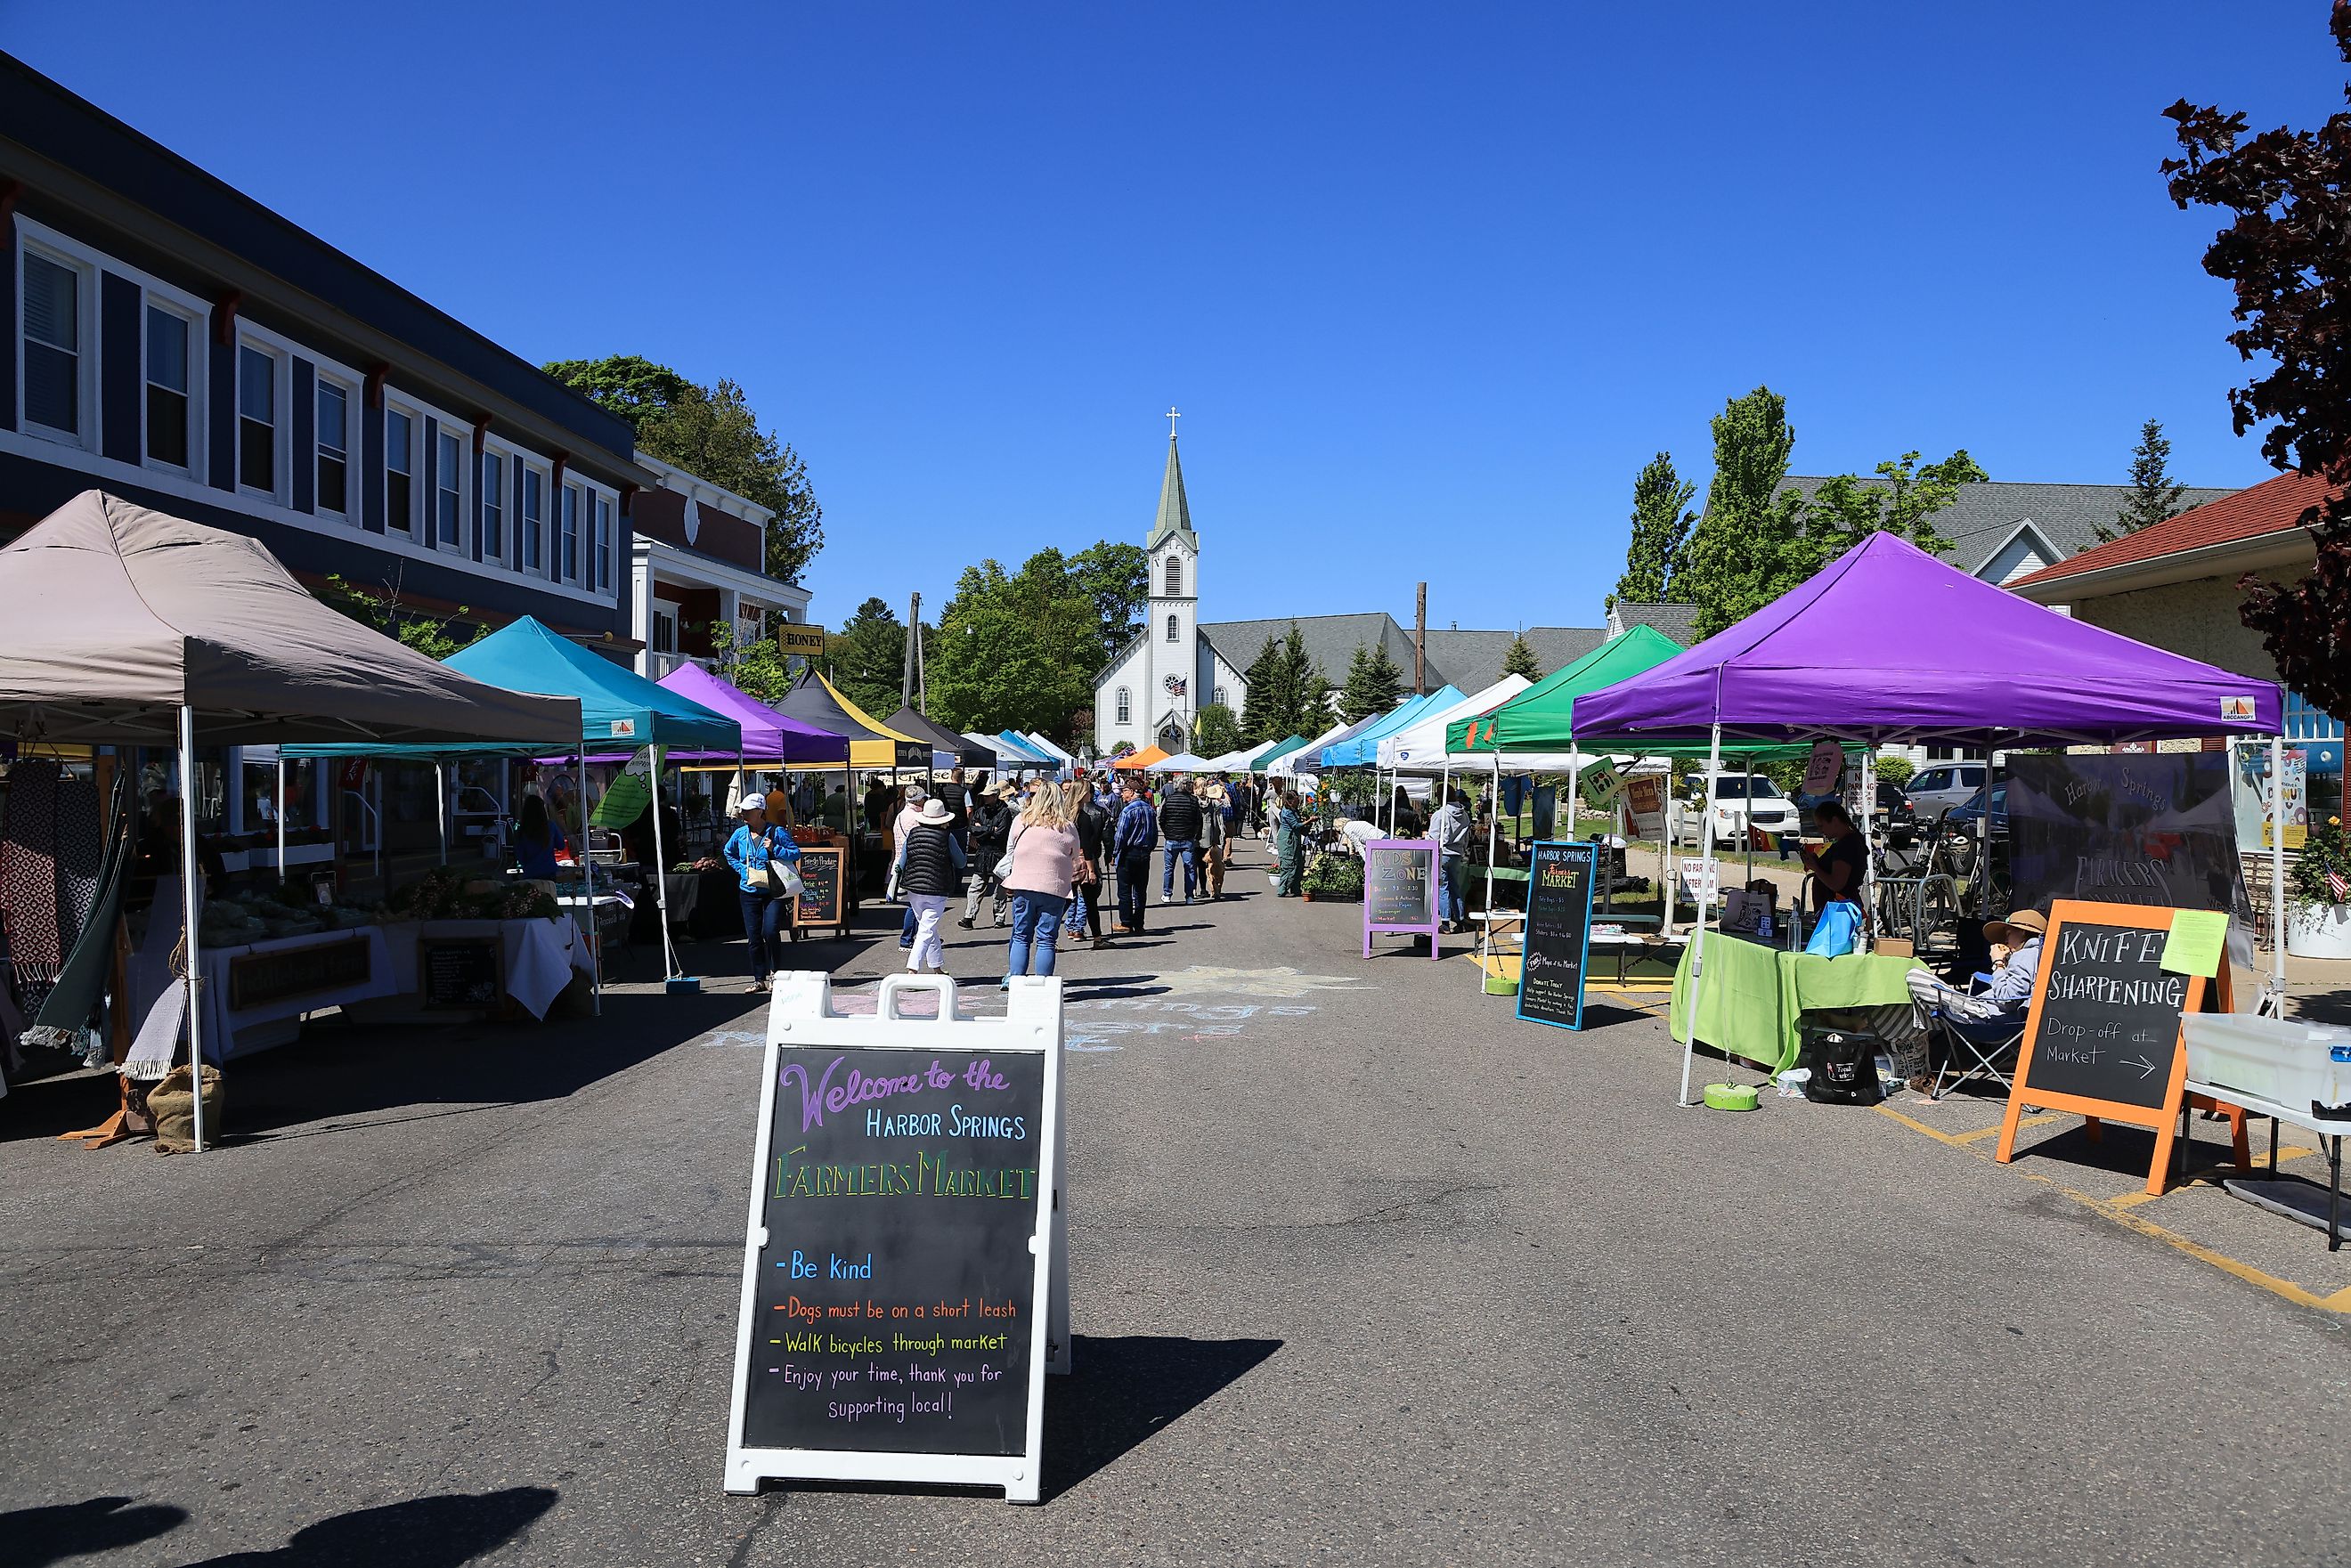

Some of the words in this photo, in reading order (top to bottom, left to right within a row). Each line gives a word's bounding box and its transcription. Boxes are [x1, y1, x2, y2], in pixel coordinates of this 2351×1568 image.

[787, 633, 821, 646] HONEY
[899, 770, 949, 781] Chese
[2064, 778, 2102, 805] Harbor
[2120, 767, 2167, 811] Springs
[2267, 787, 2303, 800] DNUT
[803, 856, 818, 866] Fresh
[818, 855, 838, 867] Produce
[1537, 850, 1560, 861] HARBOR
[1563, 850, 1591, 863] SPRINGS
[1382, 866, 1427, 881] ZONE
[1684, 863, 1692, 873] NO
[1692, 863, 1716, 873] PARNG
[1542, 869, 1580, 889] MARKET
[1684, 878, 1702, 889] AFTER
[2059, 930, 2165, 965] KNIFE
[1563, 959, 1579, 970] Market
[1533, 977, 1550, 987] DONATE
[2047, 971, 2185, 1007] SHARPENING
[2046, 1017, 2122, 1043] Drop-off
[2131, 1028, 2155, 1043] at
[2046, 1044, 2107, 1065] Market
[1837, 1065, 1852, 1073] Fresh
[780, 1056, 923, 1133] Welcome
[924, 1060, 956, 1089] to
[963, 1059, 1011, 1091] the
[866, 1108, 942, 1138] HARBOR
[948, 1104, 1027, 1141] SPRINGS
[773, 1144, 915, 1199] FARMERS
[915, 1149, 1037, 1199] MARKET
[829, 1253, 872, 1280] kind
[828, 1300, 860, 1319] must
[866, 1300, 884, 1319] be
[891, 1304, 908, 1319] on
[914, 1305, 925, 1319] a
[932, 1297, 972, 1319] short
[979, 1297, 1017, 1319] leash
[829, 1331, 883, 1360] bicycles
[892, 1331, 945, 1357] through
[951, 1332, 1008, 1352] market
[831, 1369, 859, 1390] your
[867, 1361, 904, 1385] time,
[908, 1362, 947, 1383] thank
[954, 1369, 975, 1389] you
[980, 1363, 1004, 1383] for
[828, 1394, 905, 1424] supporting
[910, 1391, 954, 1421] local!
